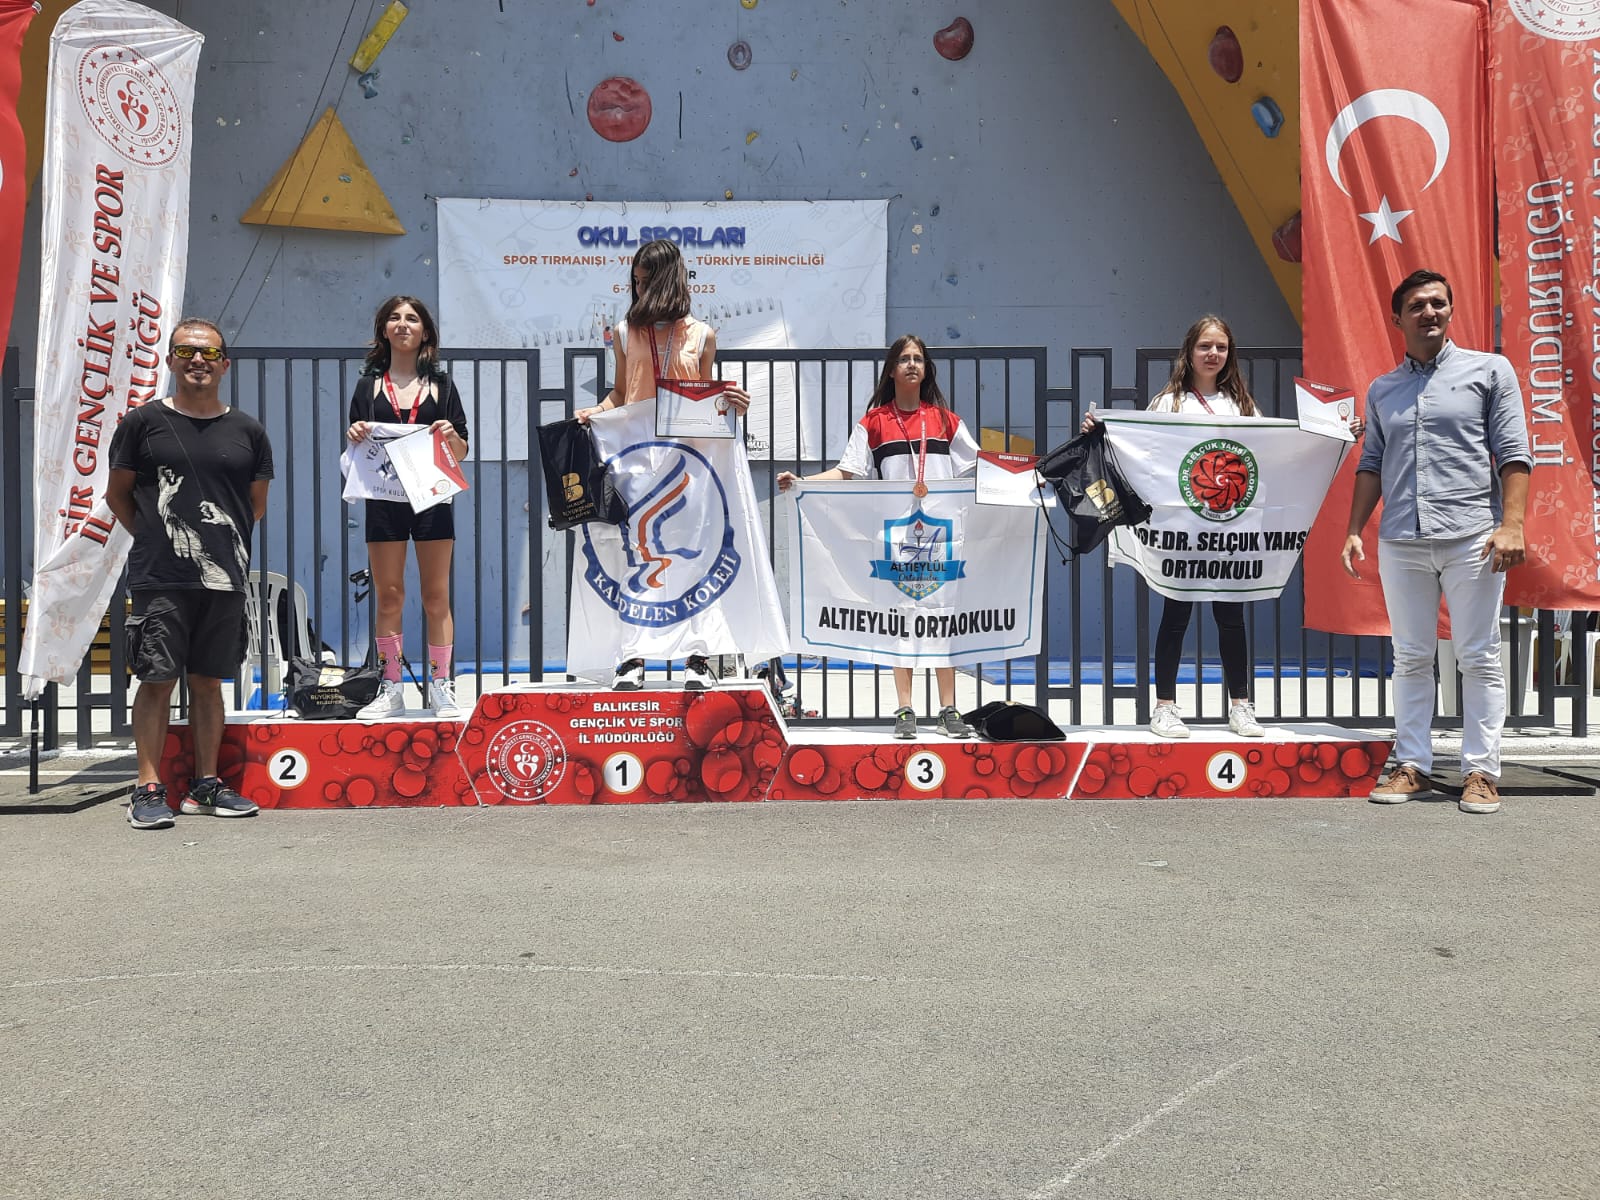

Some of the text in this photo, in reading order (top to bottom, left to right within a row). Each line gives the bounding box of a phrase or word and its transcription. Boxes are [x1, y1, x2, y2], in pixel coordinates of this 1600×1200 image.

[92, 164, 124, 259] SPOR
[577, 226, 746, 248] OKUL SPORLARI
[503, 256, 537, 265] SPOR
[541, 256, 606, 267] TIRMANIŞI
[696, 254, 751, 266] TÜRKİYE
[754, 253, 825, 266] BİRİNCİLİĞİ
[89, 259, 120, 305] VE
[73, 313, 117, 476] GENÇLİK
[1187, 442, 1218, 464] SELÇUK
[1240, 456, 1255, 508] ORTAOKULU
[1197, 531, 1261, 556] SELÇUK
[890, 560, 947, 572] ALTIEYLÜL
[1161, 558, 1263, 580] ORTAOKULU
[685, 552, 738, 611] KOLEJİ
[819, 606, 1016, 638] ALTIEYLÜL ORTAOKULU
[593, 700, 660, 712] BALIKESİR
[570, 716, 683, 729] GENÇLİK VE SPOR
[578, 731, 675, 744] İL MÜDÜRLÜĞÜ
[279, 755, 297, 780] 2
[615, 760, 628, 786] 1
[917, 759, 933, 783] 3
[1217, 759, 1236, 784] 4
